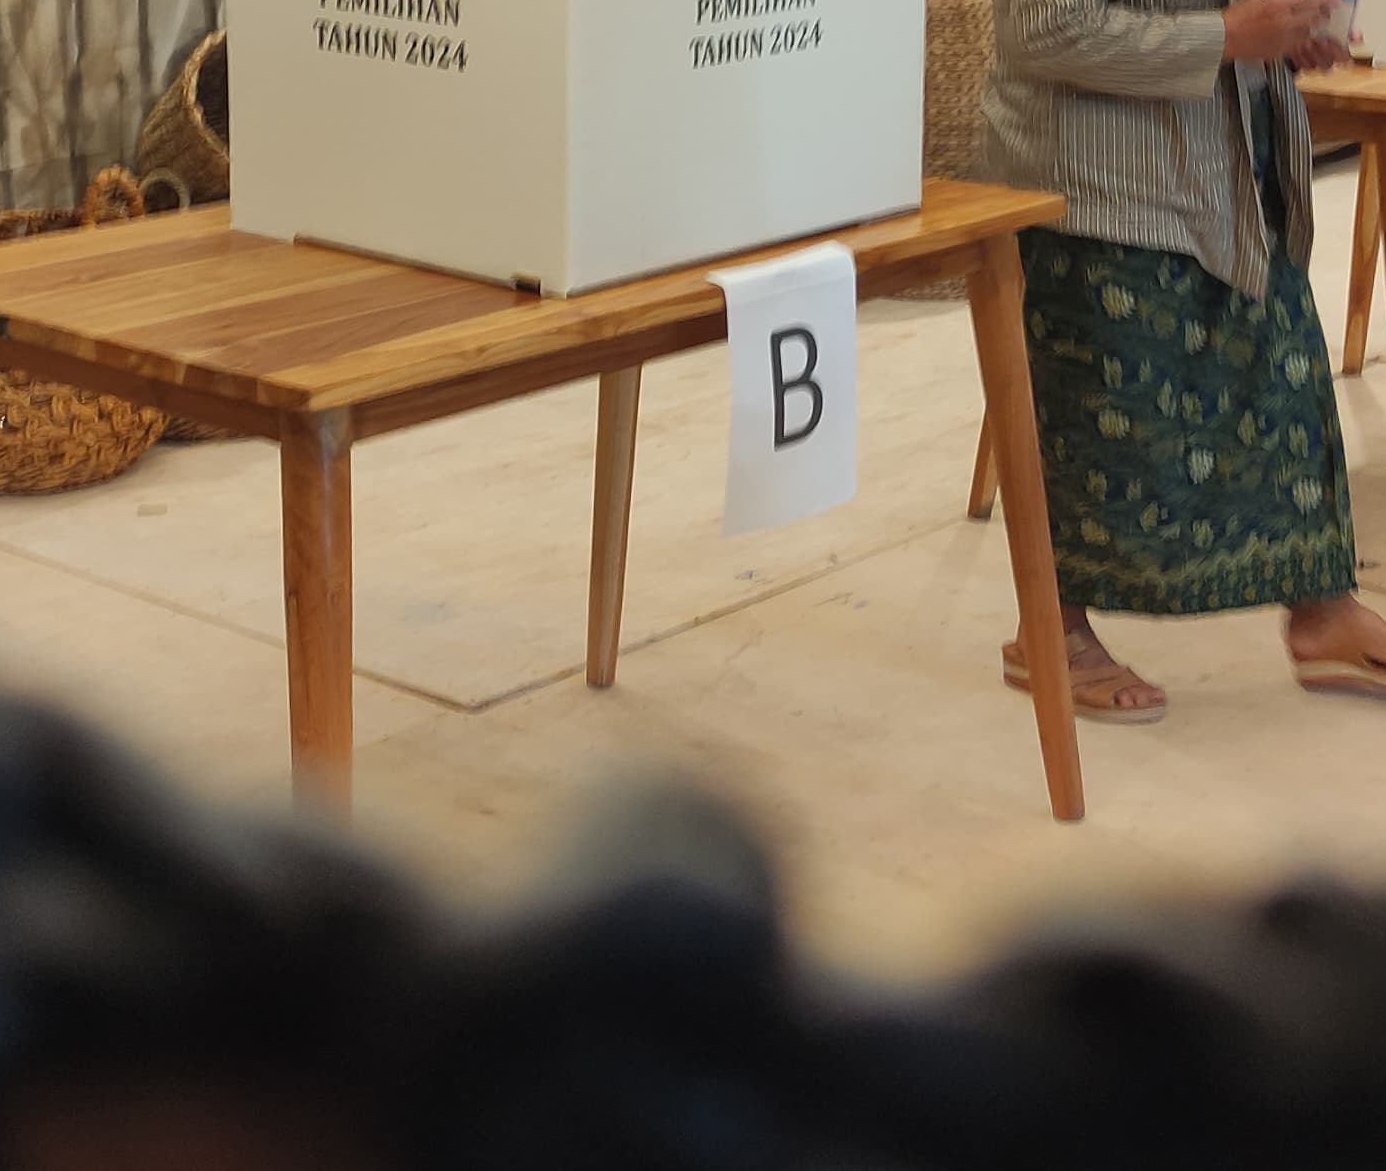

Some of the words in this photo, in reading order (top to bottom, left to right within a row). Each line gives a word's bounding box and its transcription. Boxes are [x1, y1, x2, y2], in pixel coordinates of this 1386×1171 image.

[313, 17, 398, 62] TAHUN
[404, 31, 469, 73] 2024
[689, 28, 765, 69] TAHUN
[770, 17, 822, 55] 2024
[770, 327, 824, 451] B
